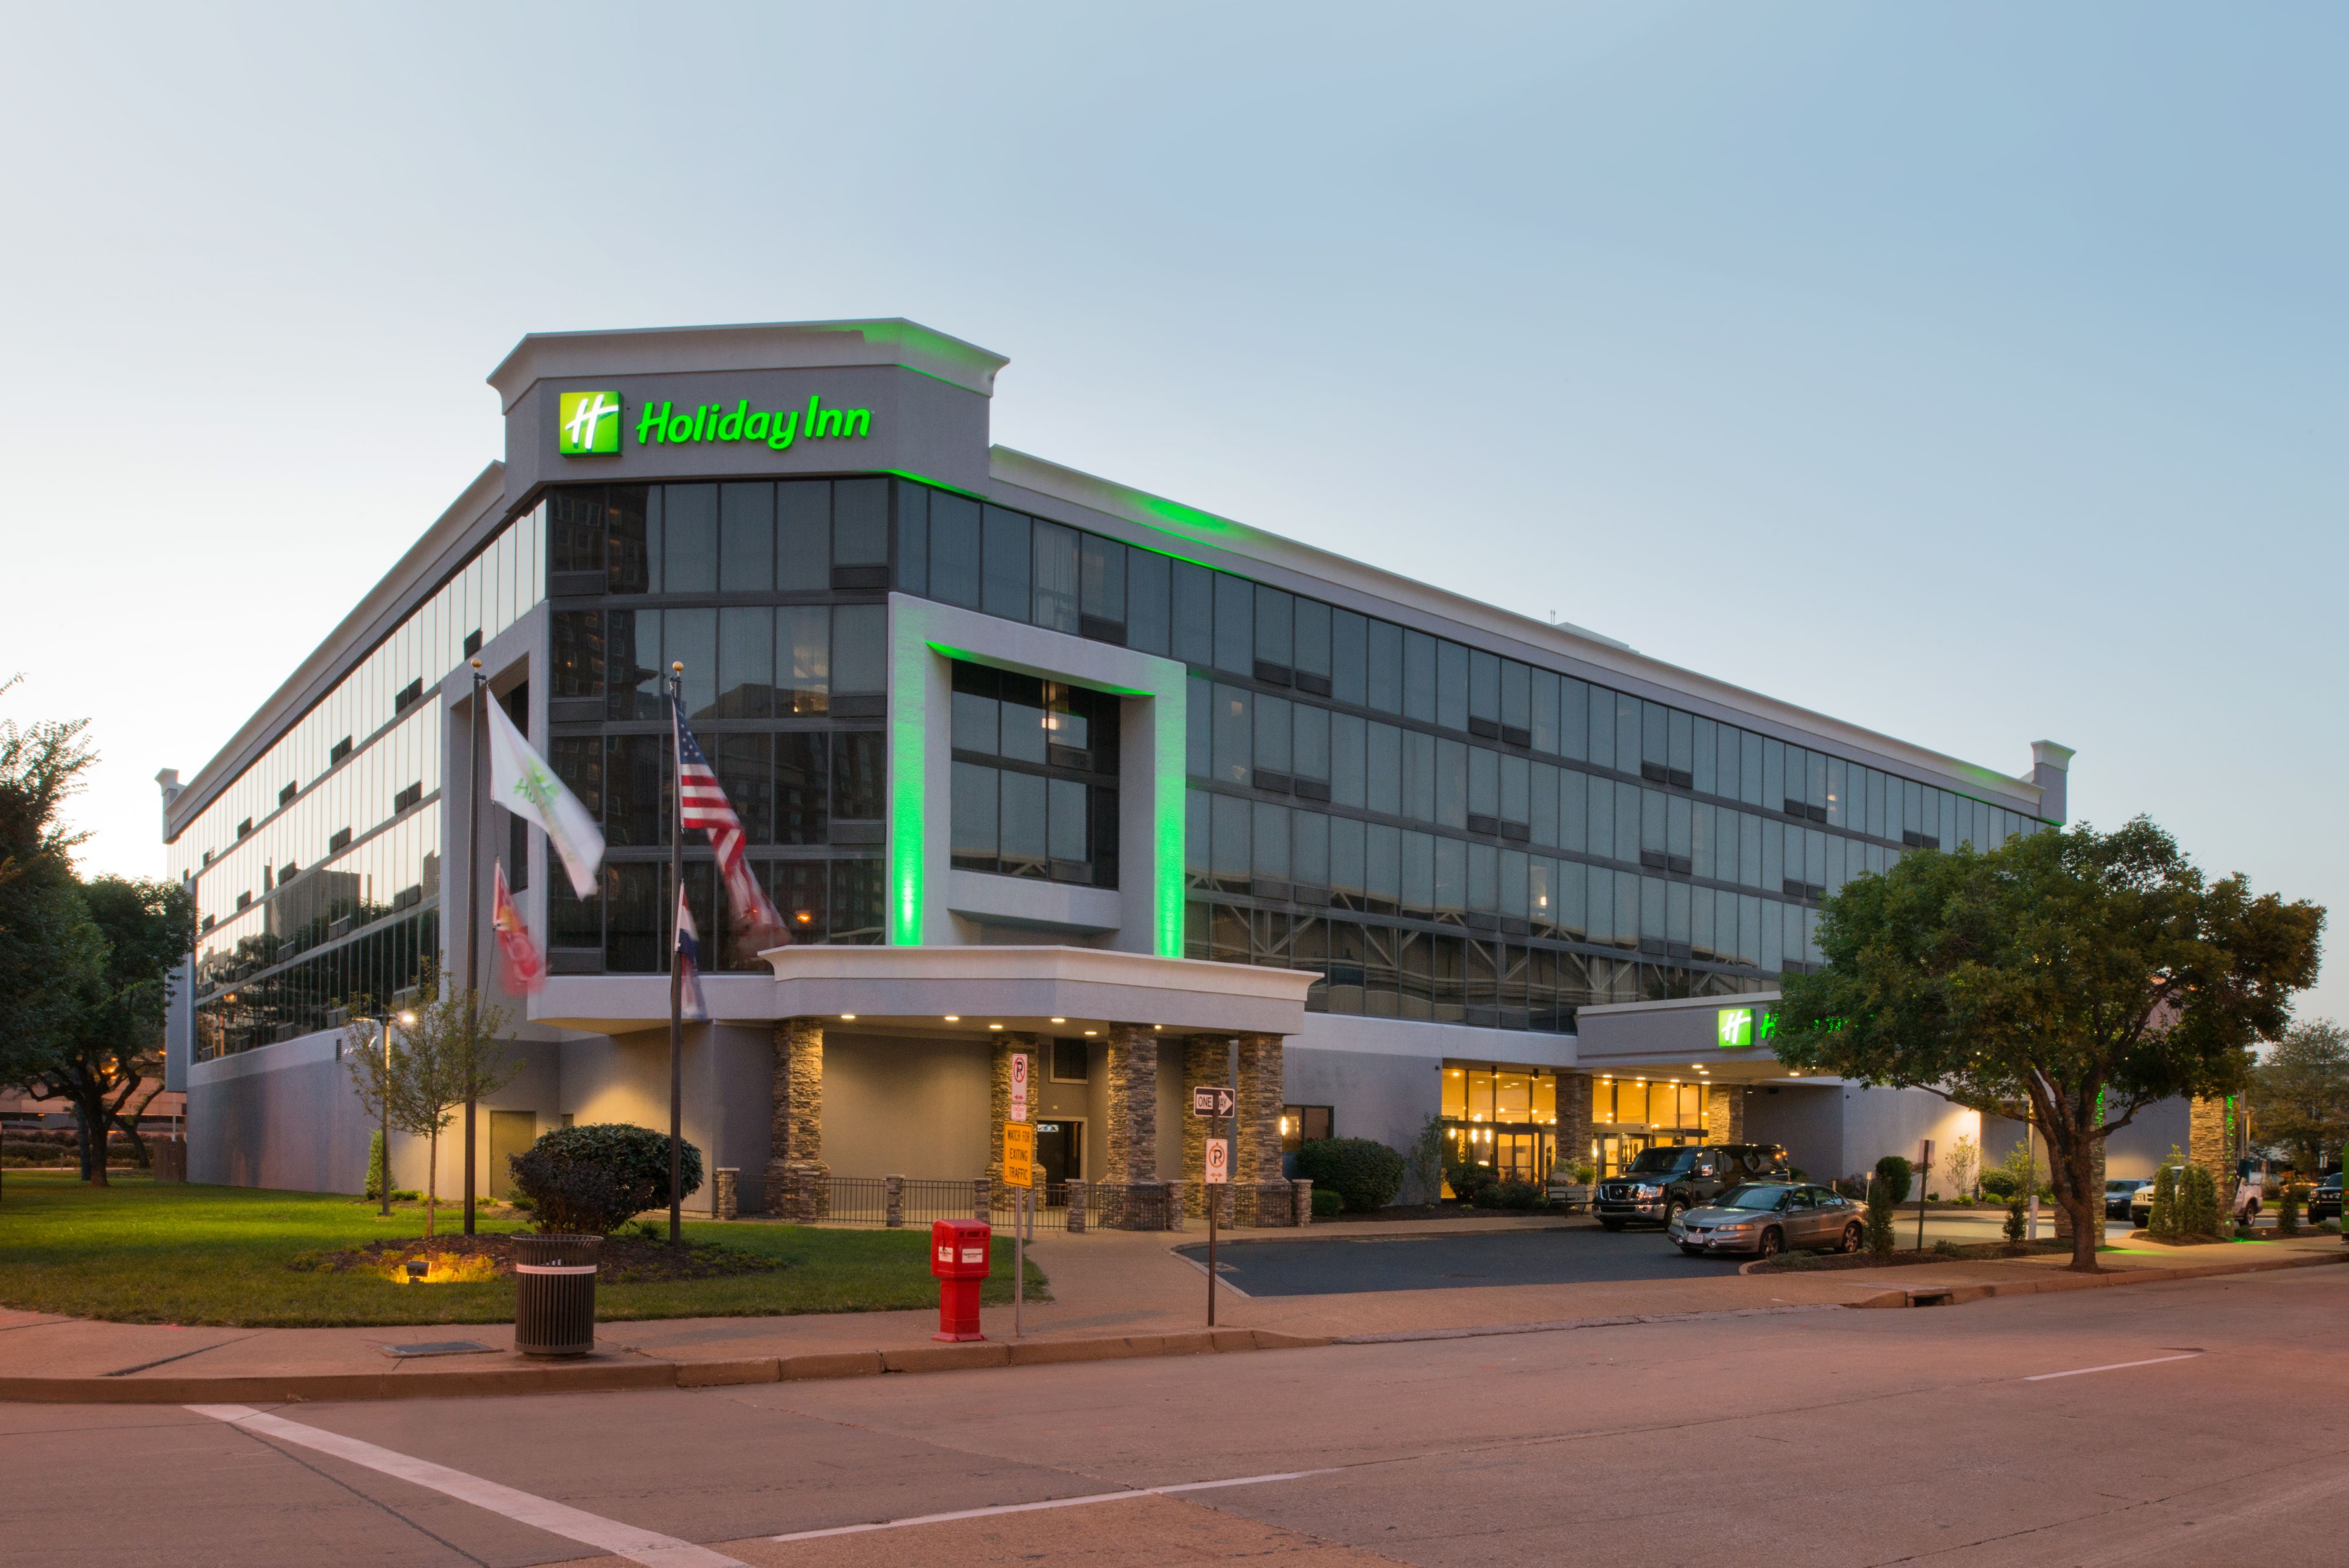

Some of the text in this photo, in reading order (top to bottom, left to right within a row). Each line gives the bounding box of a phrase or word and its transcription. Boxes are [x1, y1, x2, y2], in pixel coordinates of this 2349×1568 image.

[637, 395, 871, 450] Holiday Inn
[1198, 1096, 1212, 1108] ONE
[1008, 1130, 1020, 1141] WATCH
[1010, 1148, 1028, 1162] EXITING
[1009, 1166, 1028, 1180] TRAFFIC
